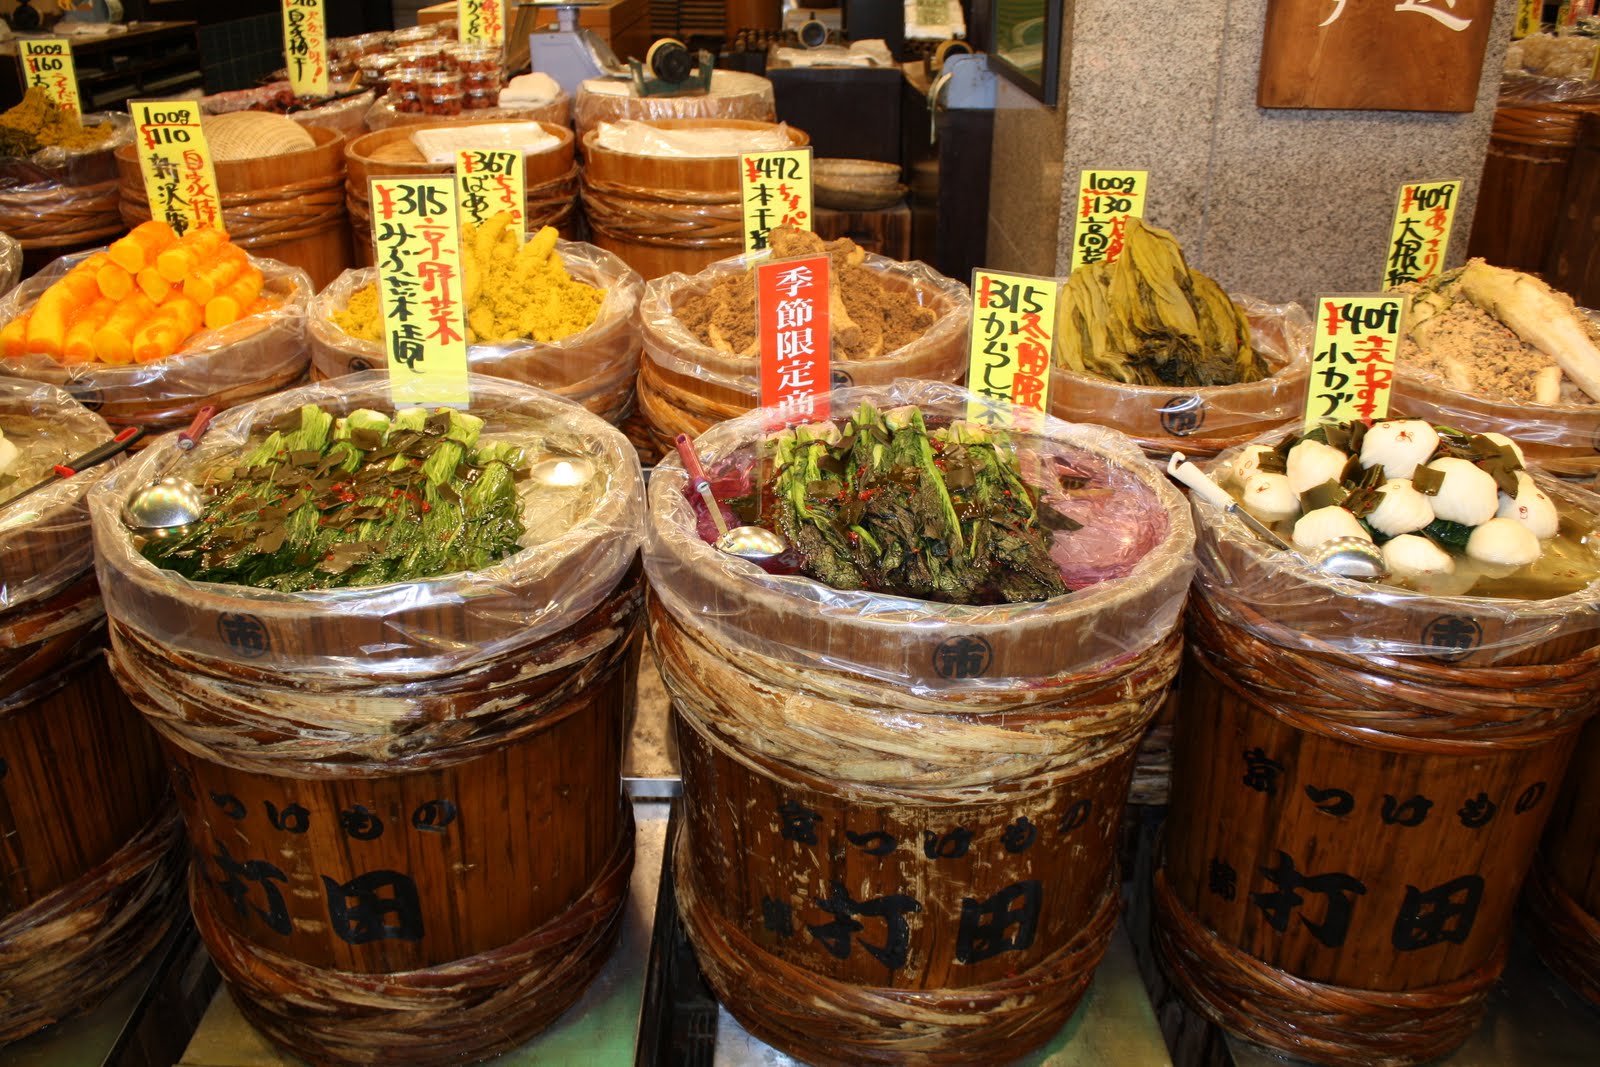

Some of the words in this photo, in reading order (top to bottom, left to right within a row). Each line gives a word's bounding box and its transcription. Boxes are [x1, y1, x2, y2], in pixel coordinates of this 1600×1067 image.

[26, 42, 62, 55] 100g
[26, 57, 63, 73] ¥160
[143, 106, 191, 125] 100g
[141, 126, 191, 149] ¥110
[461, 151, 516, 173] ¥367
[744, 157, 803, 182] ¥492
[1090, 173, 1136, 193] 100g
[1401, 184, 1455, 213] ¥409
[375, 184, 448, 220] ¥315
[1080, 196, 1132, 217] ¥130
[1418, 205, 1447, 283] あっさり
[414, 218, 463, 345] 京野菜
[977, 275, 1048, 313] ¥315
[1323, 302, 1399, 335] ¥409
[775, 265, 816, 425] 季節限定商
[1314, 342, 1357, 421] 小カブ
[1251, 850, 1485, 951] 打田
[806, 879, 1044, 970] 打田
